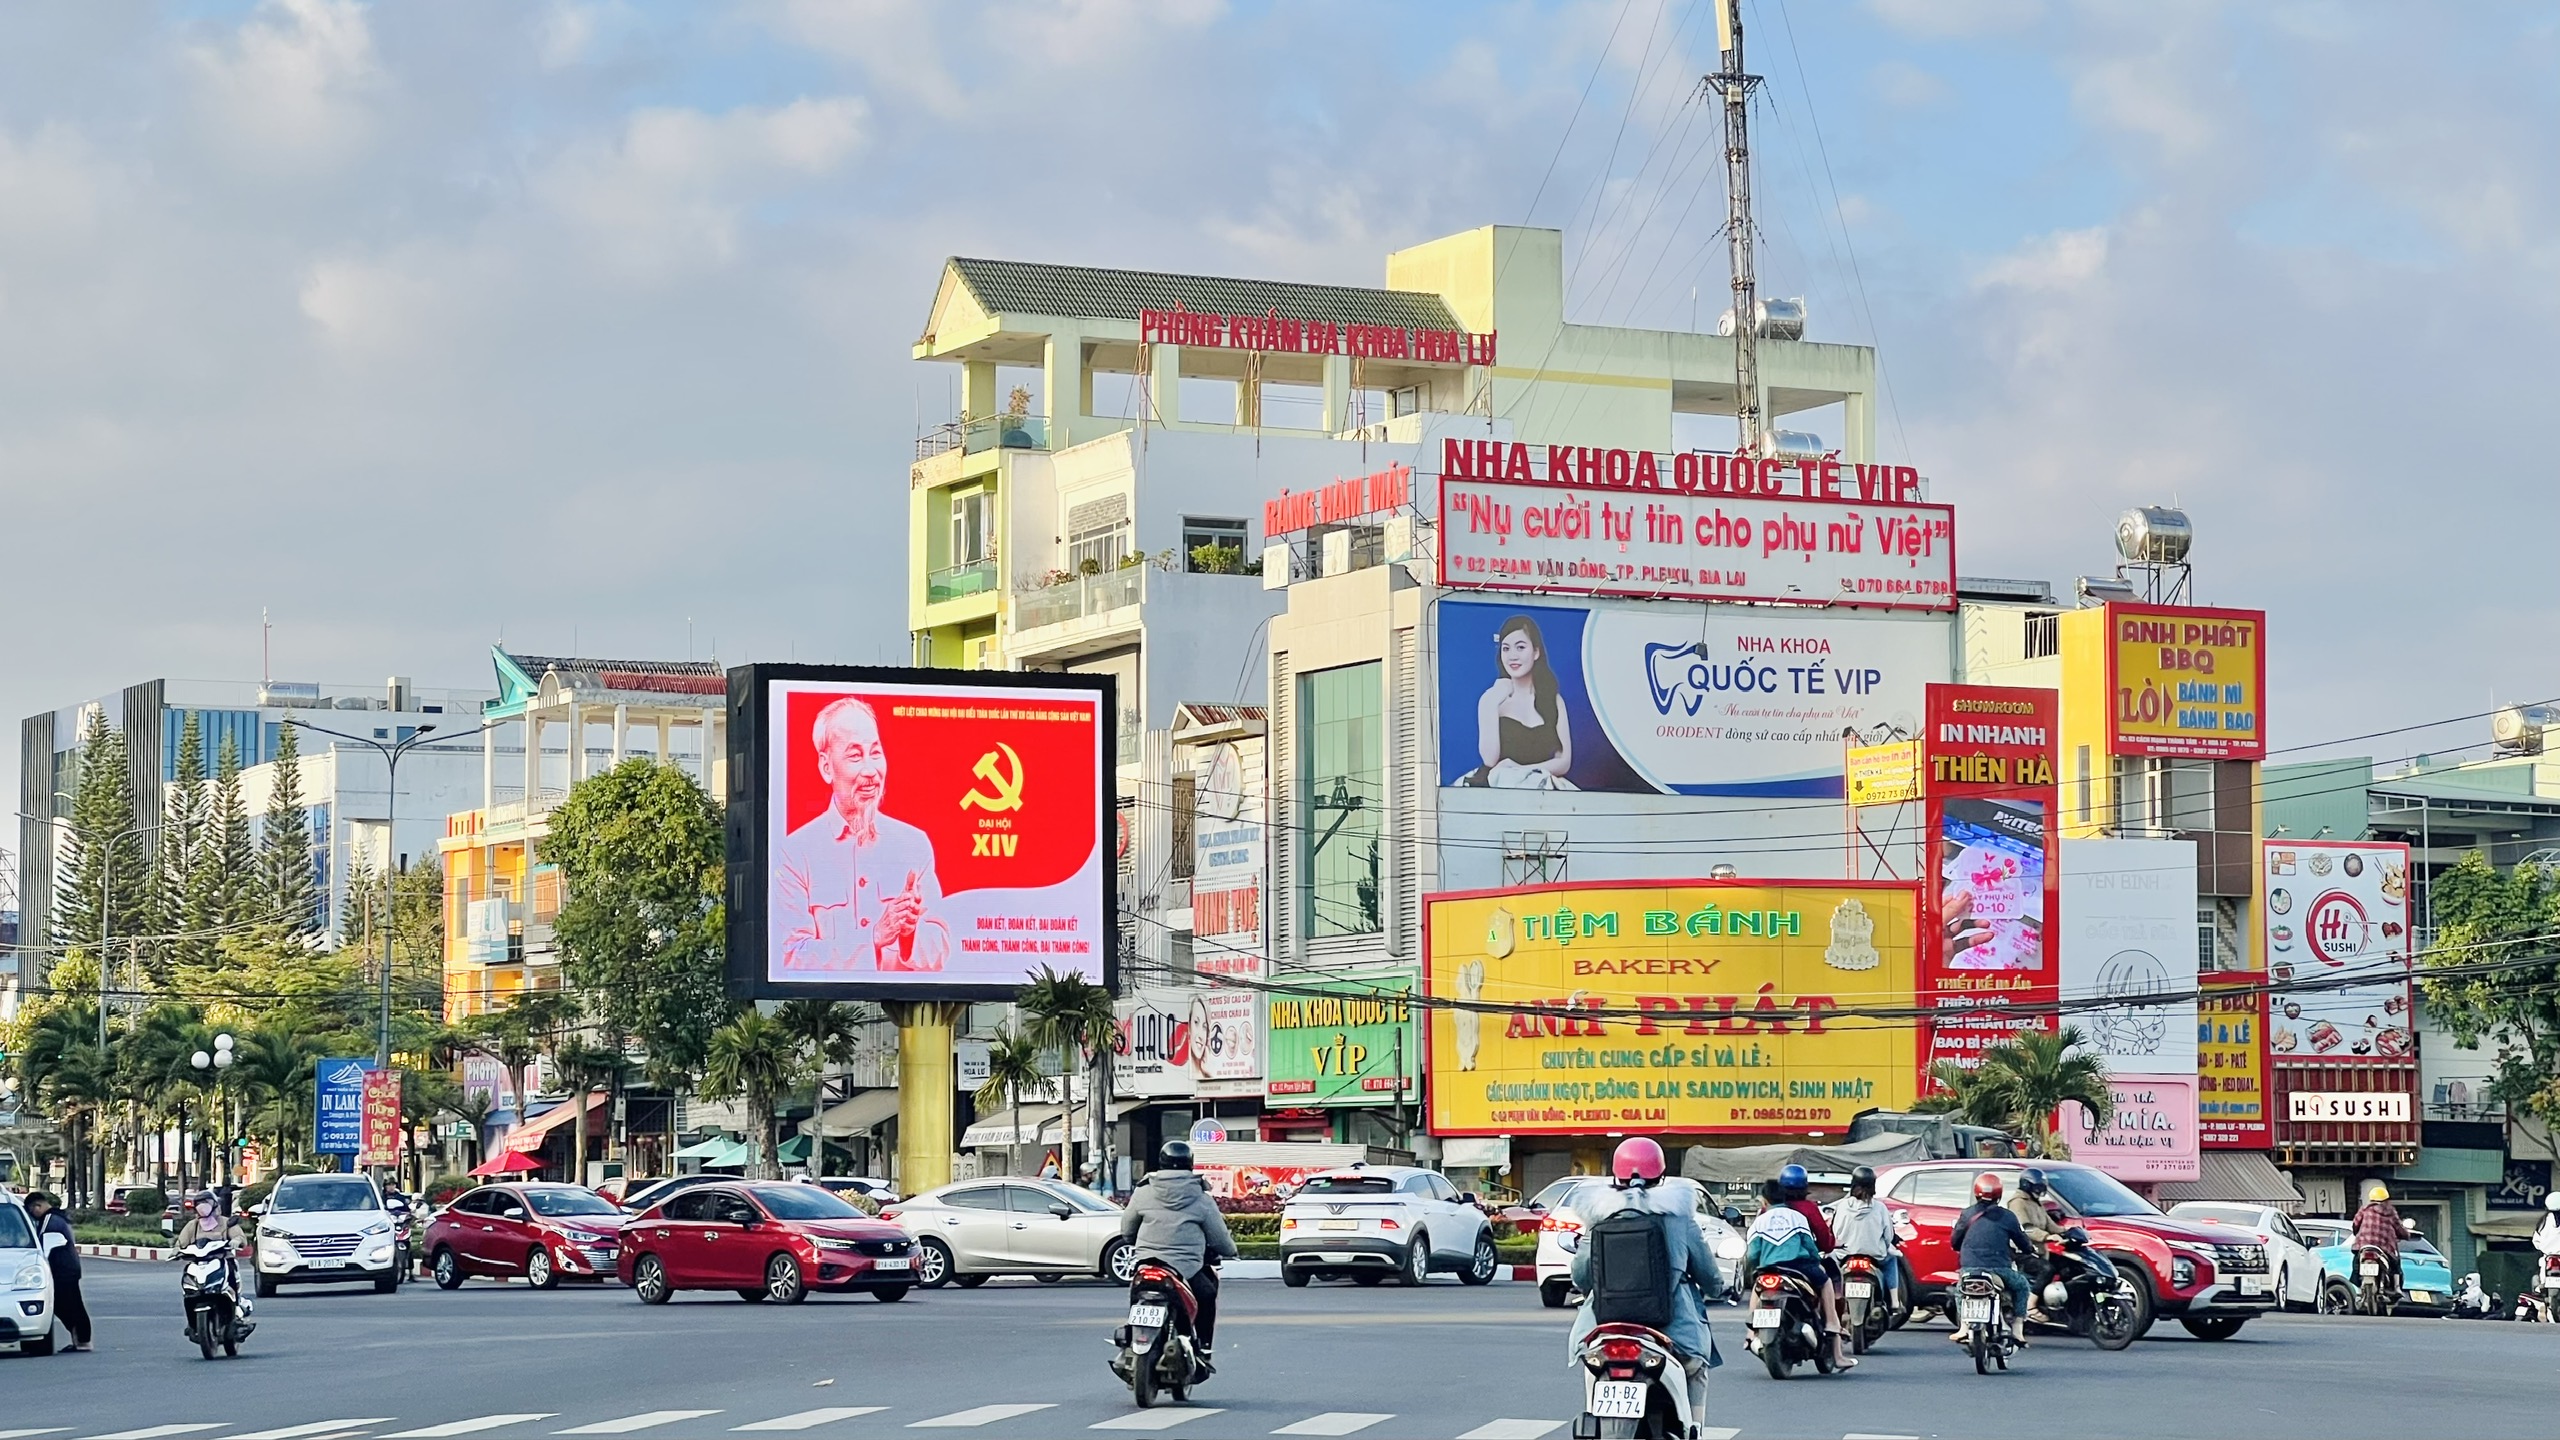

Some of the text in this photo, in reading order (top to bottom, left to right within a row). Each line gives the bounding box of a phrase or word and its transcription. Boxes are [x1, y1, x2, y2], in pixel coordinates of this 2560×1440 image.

[1140, 300, 1222, 347] PHÒNG
[1229, 307, 1302, 352] KHÁM
[1346, 322, 1409, 360] KHOA
[1414, 327, 1461, 363] HOA
[1467, 328, 1497, 366] LƯ
[1442, 437, 1919, 503] NHA KHOA QUỐC TẾ VIP
[1320, 475, 1363, 524] HÀM
[1523, 493, 1591, 539] cười
[1601, 501, 1634, 553] tự
[1645, 503, 1683, 545] tin
[1695, 508, 1752, 548] cho
[1762, 511, 1817, 563] phụ
[1827, 512, 1864, 553] nữ
[1467, 557, 1486, 572] 02
[1489, 557, 1531, 579] PHẠM
[1699, 569, 1721, 586] GIA
[1726, 570, 1746, 587] LAI
[1858, 578, 1948, 595] 070 664 6789
[2121, 620, 2252, 648] ANH PHÁT
[1737, 636, 1832, 654] NHA KHOA
[2158, 647, 2214, 674] BBQ
[1687, 657, 1881, 695] QUỐC TẾ VIP
[2119, 677, 2160, 723] LÒ
[2177, 679, 2243, 704] BÁNH MÌ
[1952, 699, 2034, 715] SHOWROOM
[2177, 705, 2254, 730] BÁNH BAO
[1656, 725, 1724, 739] ORODENT
[1725, 727, 1752, 743] dòng
[1755, 729, 1769, 741] sứ
[1770, 732, 1790, 742] cao
[1797, 727, 1812, 744] cấp
[1815, 728, 1840, 742] nhất
[1940, 724, 2046, 746] IN NHANH
[1930, 750, 2055, 784] THIÊN HÀ
[1866, 791, 1886, 801] 0972
[978, 817, 1012, 831] ĐẠI HỘI
[971, 833, 1019, 857] XIV
[1969, 902, 2006, 914] 20-10
[976, 914, 1078, 933] ĐOÀN ĐOÀN ĐẠI ĐOÀN KẾT
[1521, 903, 1801, 945] TIỆM BÁNH
[2319, 909, 2348, 940] Hi
[961, 937, 980, 952] THÀNH
[1001, 938, 1020, 953] THÀNH
[1040, 940, 1050, 955] ĐẠI
[1052, 938, 1071, 953] THÀNH
[2323, 942, 2356, 952] SUSHI
[1573, 958, 1721, 976] BAKERY
[1936, 973, 2032, 990] THIẾT KẾ IN ẤN
[1270, 985, 1411, 1030] NHA KHOA QUỐC TẾ
[1505, 982, 1838, 1039] ANH PHÁT
[1965, 1014, 2003, 1030] NHÃN
[2005, 1018, 2049, 1030] DECAL
[1135, 1013, 1176, 1061] HALO
[1935, 1037, 1965, 1048] BAO
[1966, 1034, 1980, 1049] BÌ
[1310, 1045, 1367, 1077] VIP
[1541, 1042, 1761, 1070] CHUYÊN CUNG CẤP SỈ VÀ LẺ
[466, 1061, 497, 1082] PHOTO
[1486, 1080, 1503, 1102] CÁC
[1503, 1083, 1522, 1105] LOẠI
[1522, 1079, 1551, 1102] BÁNH
[1595, 1077, 1640, 1099] BÔNG
[1646, 1081, 1681, 1099] LAN
[1686, 1080, 1784, 1102] SANDWICH,
[1789, 1081, 1826, 1099] SINH
[1832, 1076, 1874, 1103] NHẬT
[2222, 1077, 2236, 1092] HEO
[322, 1094, 356, 1111] IN LAM
[2133, 1090, 2156, 1104] TRÀ
[1542, 1106, 1566, 1122] ĐỒNG
[1573, 1109, 1611, 1122] PLEIKU
[1621, 1108, 1642, 1121] GIA
[1645, 1108, 1666, 1121] LAI
[1730, 1108, 1831, 1120] ĐT. 0985 021 970
[2330, 1100, 2401, 1116] SUSHI
[329, 1132, 359, 1140] 093 273
[2105, 1134, 2127, 1146] TRÀ
[2160, 1136, 2174, 1149] VỊ
[1603, 1385, 1638, 1400] 81-B2
[1597, 1400, 1640, 1415] 771.74
